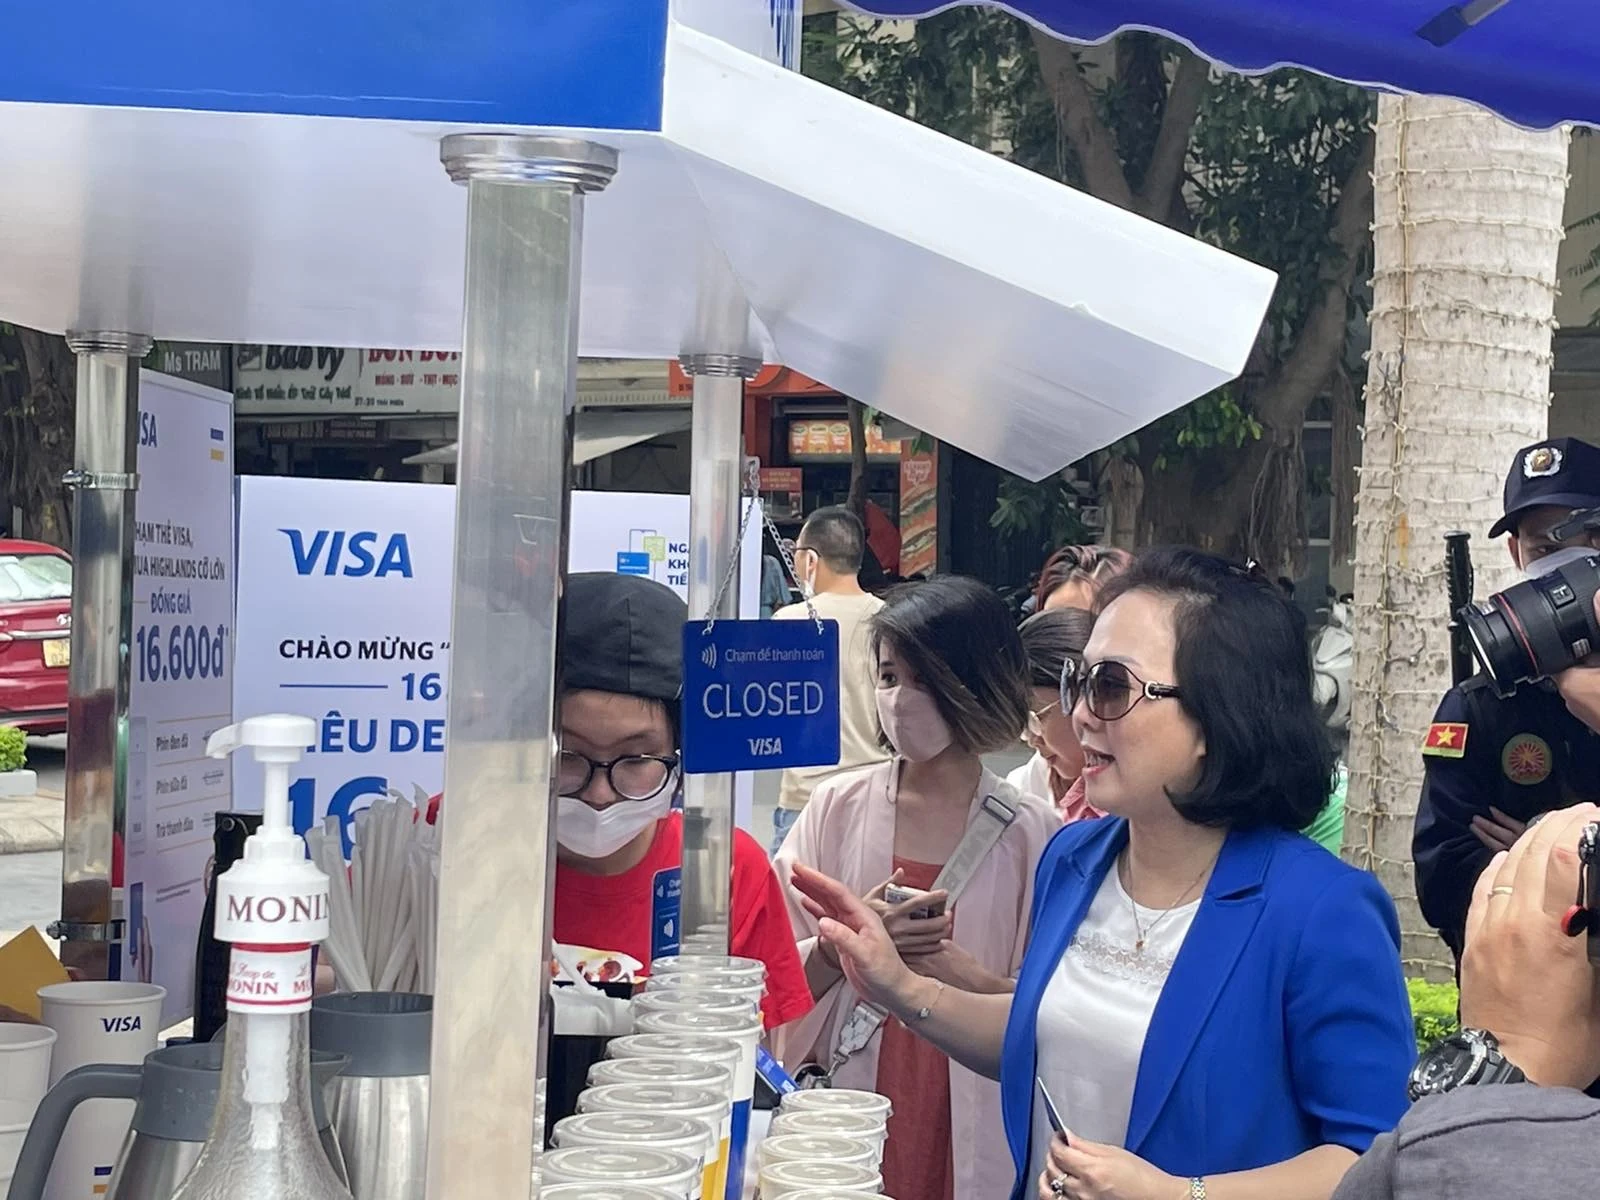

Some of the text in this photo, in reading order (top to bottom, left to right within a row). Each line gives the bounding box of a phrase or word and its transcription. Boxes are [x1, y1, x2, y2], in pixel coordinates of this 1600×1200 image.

[137, 411, 158, 448] ISA
[136, 521, 155, 547] HẠM
[276, 528, 413, 579] VISA
[668, 542, 690, 554] NG
[150, 555, 197, 579] HIGHLANDS
[668, 558, 690, 570] KH
[667, 571, 688, 586] TIẾ
[279, 634, 435, 661] CHÀO MỪNG
[724, 648, 757, 664] Chạm
[772, 647, 801, 662] thanh
[401, 672, 442, 701] 16
[702, 681, 824, 719] CLOSED
[306, 710, 378, 754] ÊU
[748, 737, 783, 756] VISA
[100, 1016, 142, 1032] VISA
